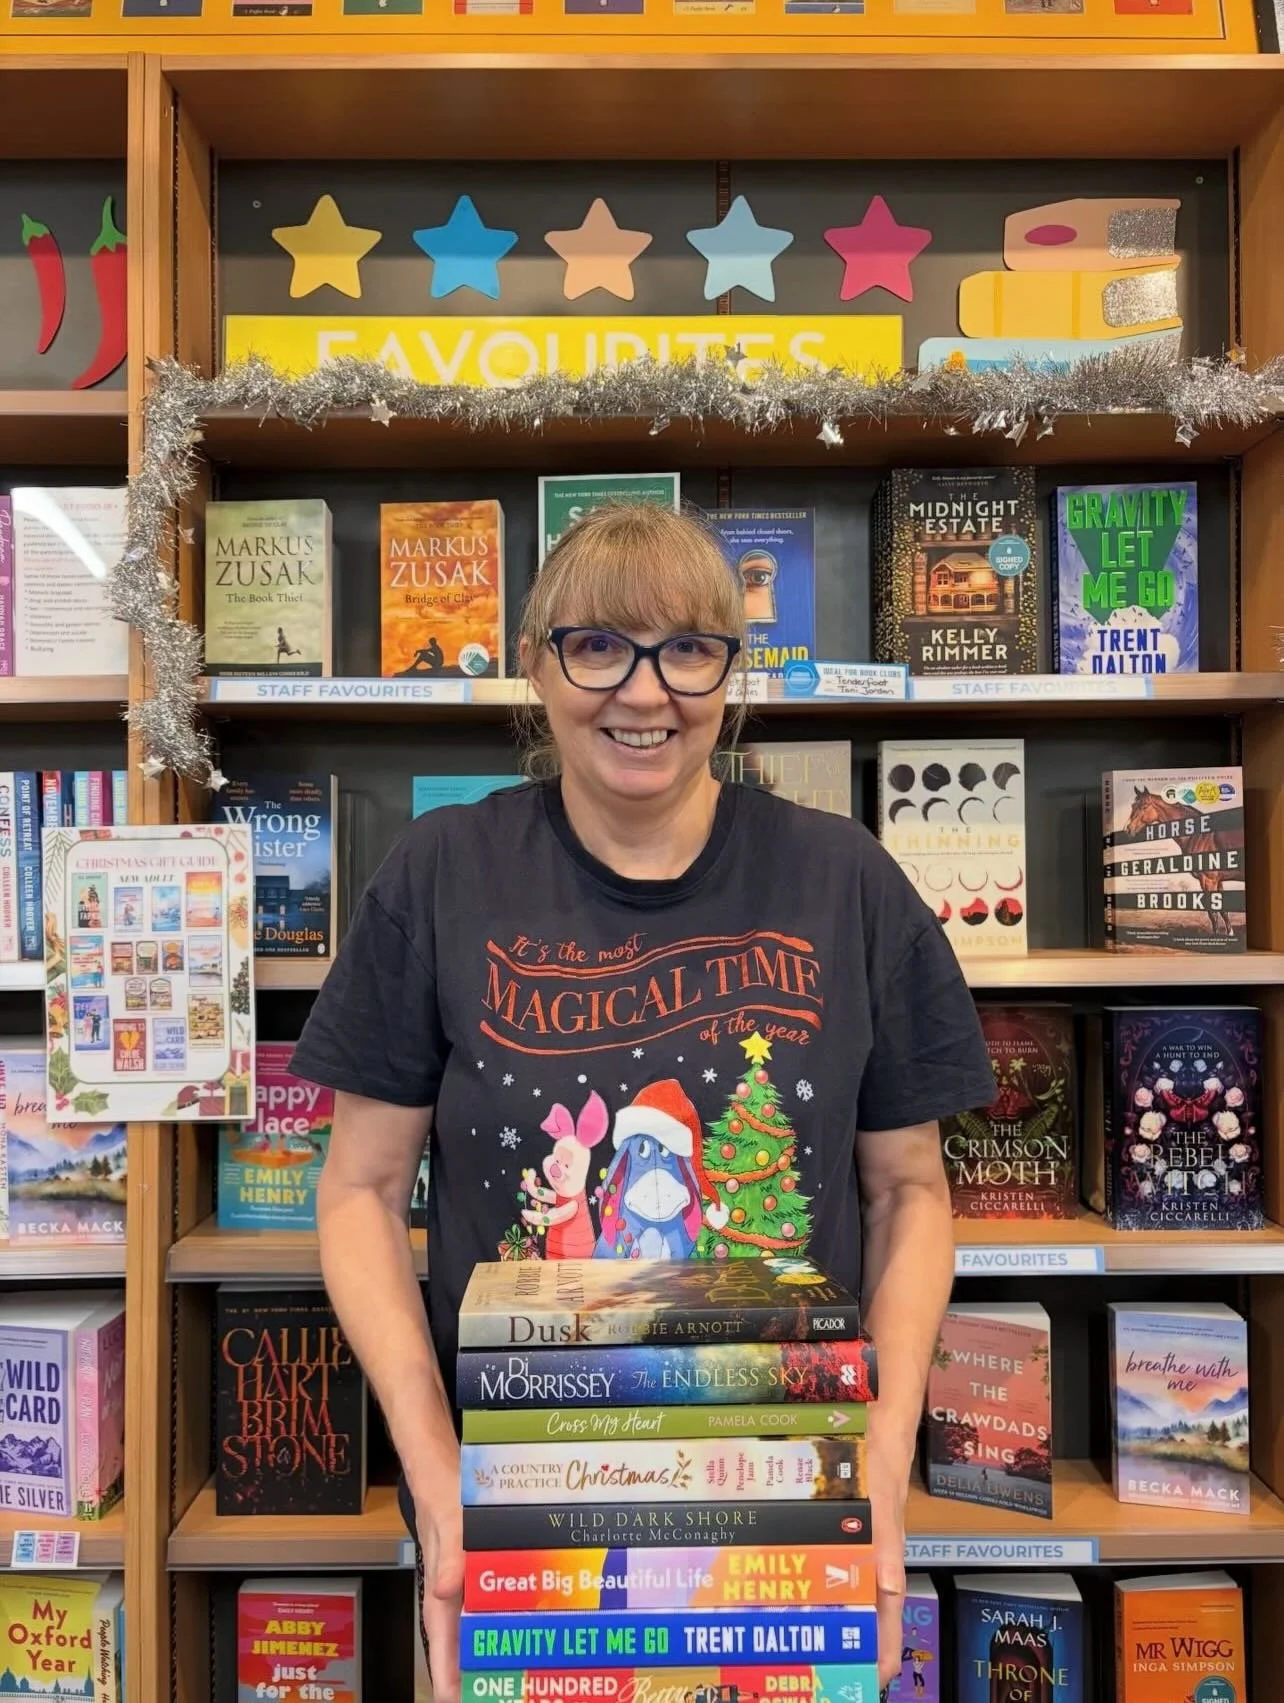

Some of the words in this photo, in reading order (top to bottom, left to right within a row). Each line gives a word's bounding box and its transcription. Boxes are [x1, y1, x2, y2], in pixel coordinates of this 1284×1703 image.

[909, 500, 1019, 518] MIDNIGHT
[1066, 490, 1188, 529] GRAVITY
[925, 517, 1003, 534] ESTATE
[216, 535, 313, 556] MARKUS
[390, 536, 489, 558] MARKUS
[1101, 530, 1154, 569] LET
[215, 560, 317, 587] ZUSAK
[390, 560, 493, 588] ZUSAK
[249, 592, 273, 604] Book
[405, 593, 438, 607] Bridge
[440, 593, 452, 604] of
[1081, 571, 1127, 609] ME
[1138, 570, 1175, 608] GO
[748, 633, 769, 645] THE
[931, 628, 999, 645] KELLY
[1097, 628, 1161, 652] TRENT
[922, 644, 1008, 662] RIMMER
[1091, 653, 1167, 674] DALTON
[256, 684, 313, 697] STAFF
[319, 684, 433, 698] FAVOURITES
[951, 683, 1004, 696] STAFF
[22, 805, 31, 817] OF
[45, 779, 58, 828] NOVEMBE
[264, 800, 282, 810] The
[221, 805, 322, 842] Wrong
[1145, 815, 1212, 841] HORSE
[890, 834, 1021, 849] THINNING
[75, 856, 146, 870] CHRISTMAS
[1120, 851, 1239, 876] GERALDINE
[1136, 892, 1223, 910] BROOKS
[24, 901, 35, 932] HOOVER
[265, 927, 325, 945] Douglas
[556, 940, 589, 963] the
[598, 932, 649, 963] most
[481, 958, 703, 1034] MAGICAL
[705, 946, 824, 1008] TIME
[700, 1020, 721, 1046] of
[724, 1011, 760, 1035] the
[765, 1022, 812, 1045] year
[255, 1083, 321, 1113] appy
[992, 1124, 1022, 1137] THE
[1173, 1131, 1208, 1145] THE
[944, 1134, 1069, 1160] CRIMSON
[1150, 1143, 1235, 1169] REBEL
[244, 1167, 304, 1186] EMILY
[956, 1160, 1057, 1185] MOTH
[239, 1186, 309, 1206] HENRY
[970, 1201, 1045, 1211] CICCARELLI
[981, 1191, 1035, 1201] KRISTEN
[1161, 1201, 1219, 1211] KRISTEN
[18, 1222, 71, 1235] BECKA
[77, 1220, 125, 1234] MACK
[1150, 1211, 1230, 1222] CICCARELLI
[961, 1252, 1068, 1267] FAVOURITES
[514, 1266, 542, 1297] ROBBIE
[508, 1312, 593, 1344] Dusk
[607, 1321, 668, 1336] ROBBIE
[674, 1320, 744, 1335] ARNOTT
[812, 1317, 846, 1331] PICADOR
[222, 1327, 351, 1367] CALLIE
[508, 1357, 530, 1377] Di
[951, 1349, 1025, 1375] WHERE
[1125, 1349, 1192, 1375] breathe
[1195, 1354, 1240, 1380] with
[6, 1359, 60, 1393] WILD
[236, 1363, 330, 1402] HART
[480, 1371, 616, 1401] MORRISSEY
[632, 1368, 657, 1390] The
[662, 1367, 759, 1388] ENDLESS
[768, 1366, 809, 1386] SKY
[1166, 1380, 1199, 1392] me
[969, 1381, 1009, 1402] THE
[5, 1392, 61, 1425] CARD
[241, 1399, 335, 1441] BRIM
[547, 1411, 588, 1436] Cross
[590, 1413, 619, 1435] My
[621, 1410, 667, 1434] Heart
[708, 1415, 756, 1427] PAMELA
[760, 1414, 798, 1426] COOK
[931, 1406, 1049, 1441] CRAWDADS
[221, 1434, 351, 1478] STONE
[963, 1440, 1016, 1465] SING
[491, 1464, 499, 1475] A
[501, 1463, 564, 1475] COUNTRY
[566, 1459, 670, 1491] Christmas
[706, 1459, 715, 1485] Stella
[736, 1452, 745, 1491] Penelope
[766, 1455, 774, 1487] Pamela
[776, 1458, 785, 1483] Cook
[499, 1477, 561, 1490] PRACTICE
[936, 1473, 982, 1494] DELIA
[985, 1483, 1045, 1506] OWENS
[1127, 1479, 1184, 1497] BECKA
[1190, 1486, 1240, 1502] MACK
[18, 1489, 65, 1512] SILVER
[549, 1512, 605, 1528] WILD
[616, 1511, 675, 1527] DARK
[685, 1510, 757, 1526] SHORE
[570, 1528, 642, 1543] Charlotte
[649, 1527, 736, 1544] McConaghy
[904, 1544, 952, 1558] STAFF
[956, 1544, 1064, 1558] FAVOURITES
[728, 1553, 807, 1576] EMILY
[479, 1570, 537, 1593] Great
[542, 1570, 574, 1597] Big
[579, 1568, 671, 1590] Beautiful
[676, 1567, 714, 1589] Life
[722, 1579, 812, 1602] HENRY
[32, 1599, 68, 1630] My
[980, 1608, 1044, 1630] SARAH
[1049, 1616, 1063, 1633] J.
[8, 1622, 93, 1650] Oxford
[264, 1620, 327, 1636] ABBY
[994, 1630, 1048, 1648] MAAS
[251, 1640, 340, 1658] JIMENEZ
[473, 1628, 557, 1657] GRAVITY
[563, 1628, 600, 1656] LET
[606, 1627, 636, 1655] ME
[644, 1627, 669, 1655] GO
[684, 1627, 746, 1654] TRENT
[752, 1625, 826, 1654] DALTON
[1135, 1642, 1168, 1660] MR
[1169, 1636, 1234, 1659] WIGG
[26, 1649, 77, 1673] Year
[1132, 1663, 1169, 1673] INGA
[1172, 1661, 1236, 1672] SIMPSON
[271, 1663, 318, 1683] just
[764, 1675, 824, 1693] DEBRA
[972, 1659, 1070, 1687] THRONE
[255, 1682, 291, 1699] for
[299, 1683, 336, 1700] the
[473, 1676, 515, 1697] ONE
[521, 1675, 618, 1696] HUNDRED
[1009, 1688, 1033, 1702] OF
